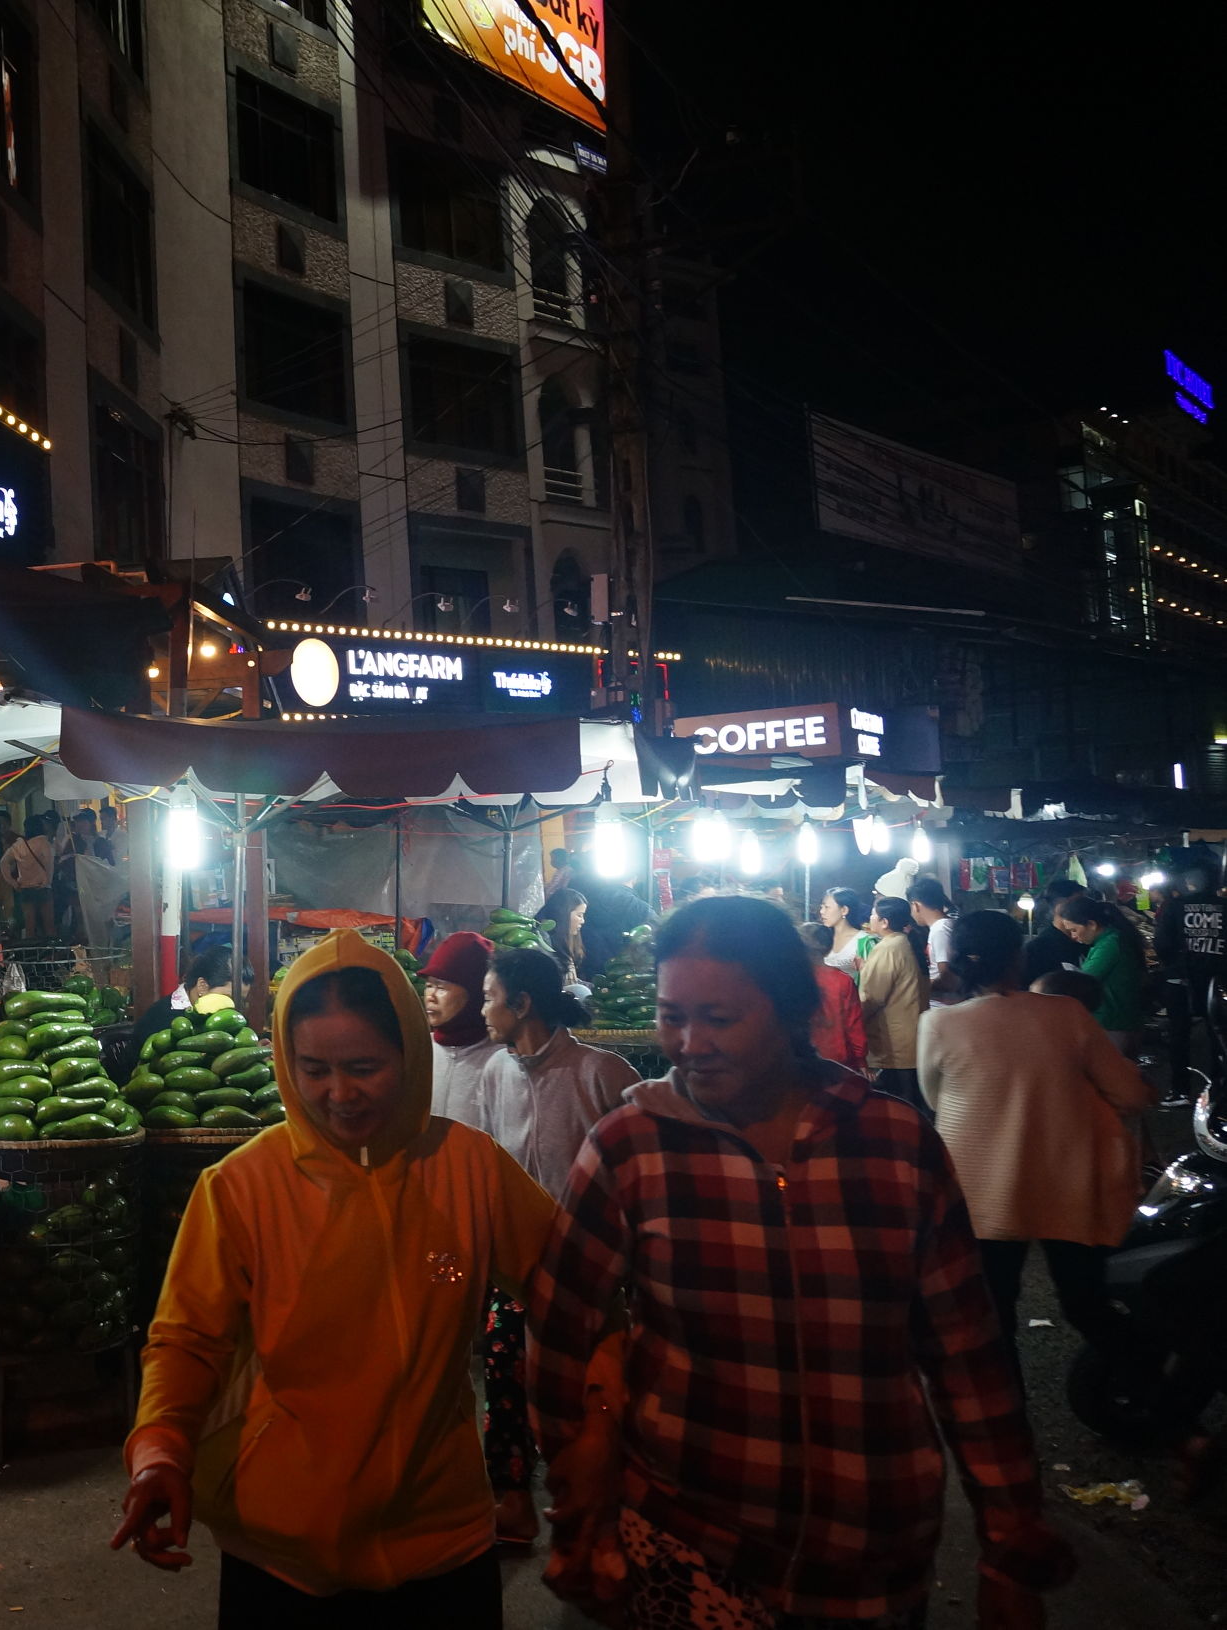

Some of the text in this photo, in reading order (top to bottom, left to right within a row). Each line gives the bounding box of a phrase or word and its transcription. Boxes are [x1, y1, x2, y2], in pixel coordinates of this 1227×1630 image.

[503, 23, 537, 64] phí
[346, 649, 463, 681] L'ANGFARM
[693, 715, 827, 755] COFFEE
[1184, 912, 1223, 929] COME
